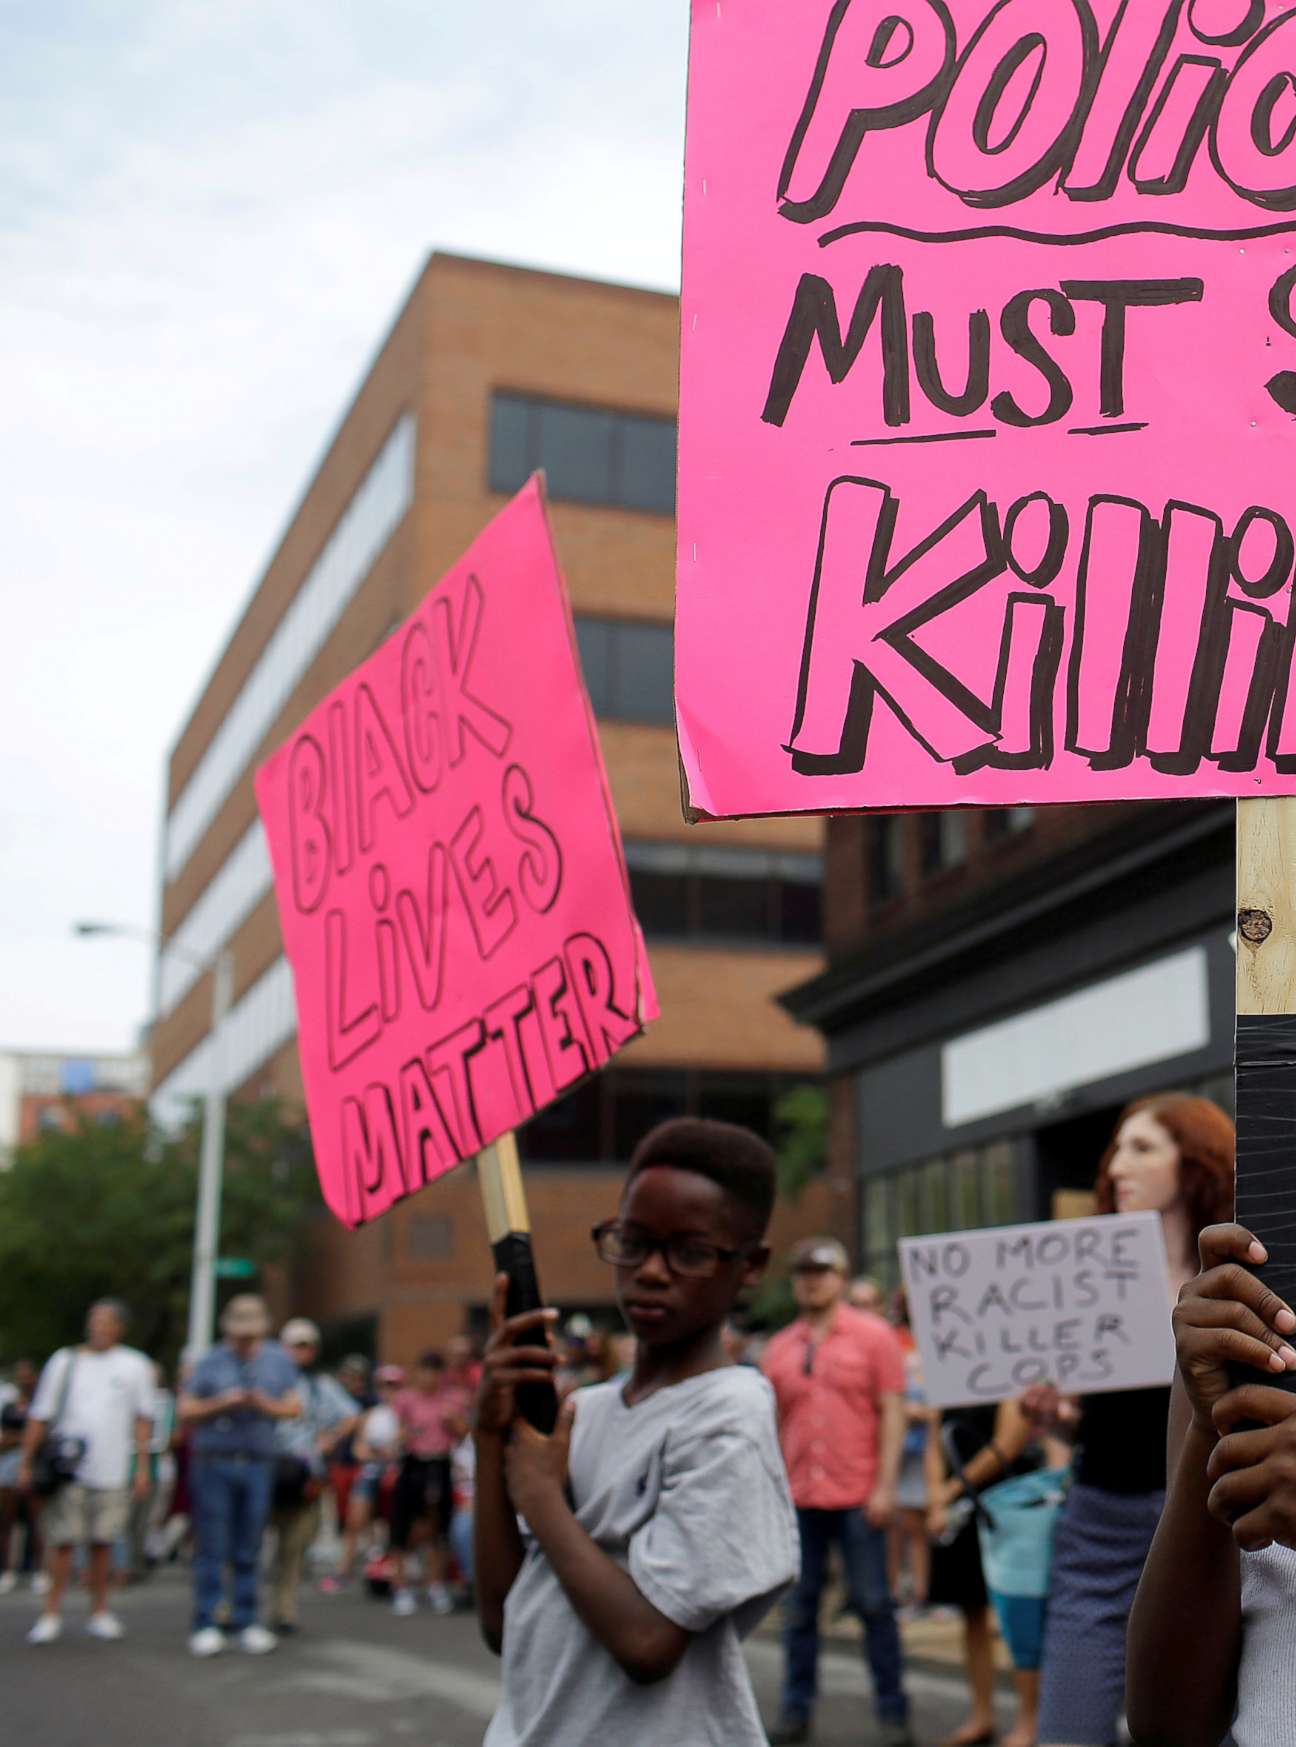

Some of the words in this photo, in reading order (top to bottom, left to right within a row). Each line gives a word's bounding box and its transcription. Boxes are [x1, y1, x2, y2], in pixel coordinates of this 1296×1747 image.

[760, 262, 1204, 428] MUST
[340, 931, 644, 1231] MATTER
[907, 1242, 971, 1282] NO
[995, 1228, 1140, 1269] MORE
[928, 1267, 1138, 1326] RACIST
[931, 1314, 1131, 1361] KILLER
[965, 1350, 1114, 1397] COPS
